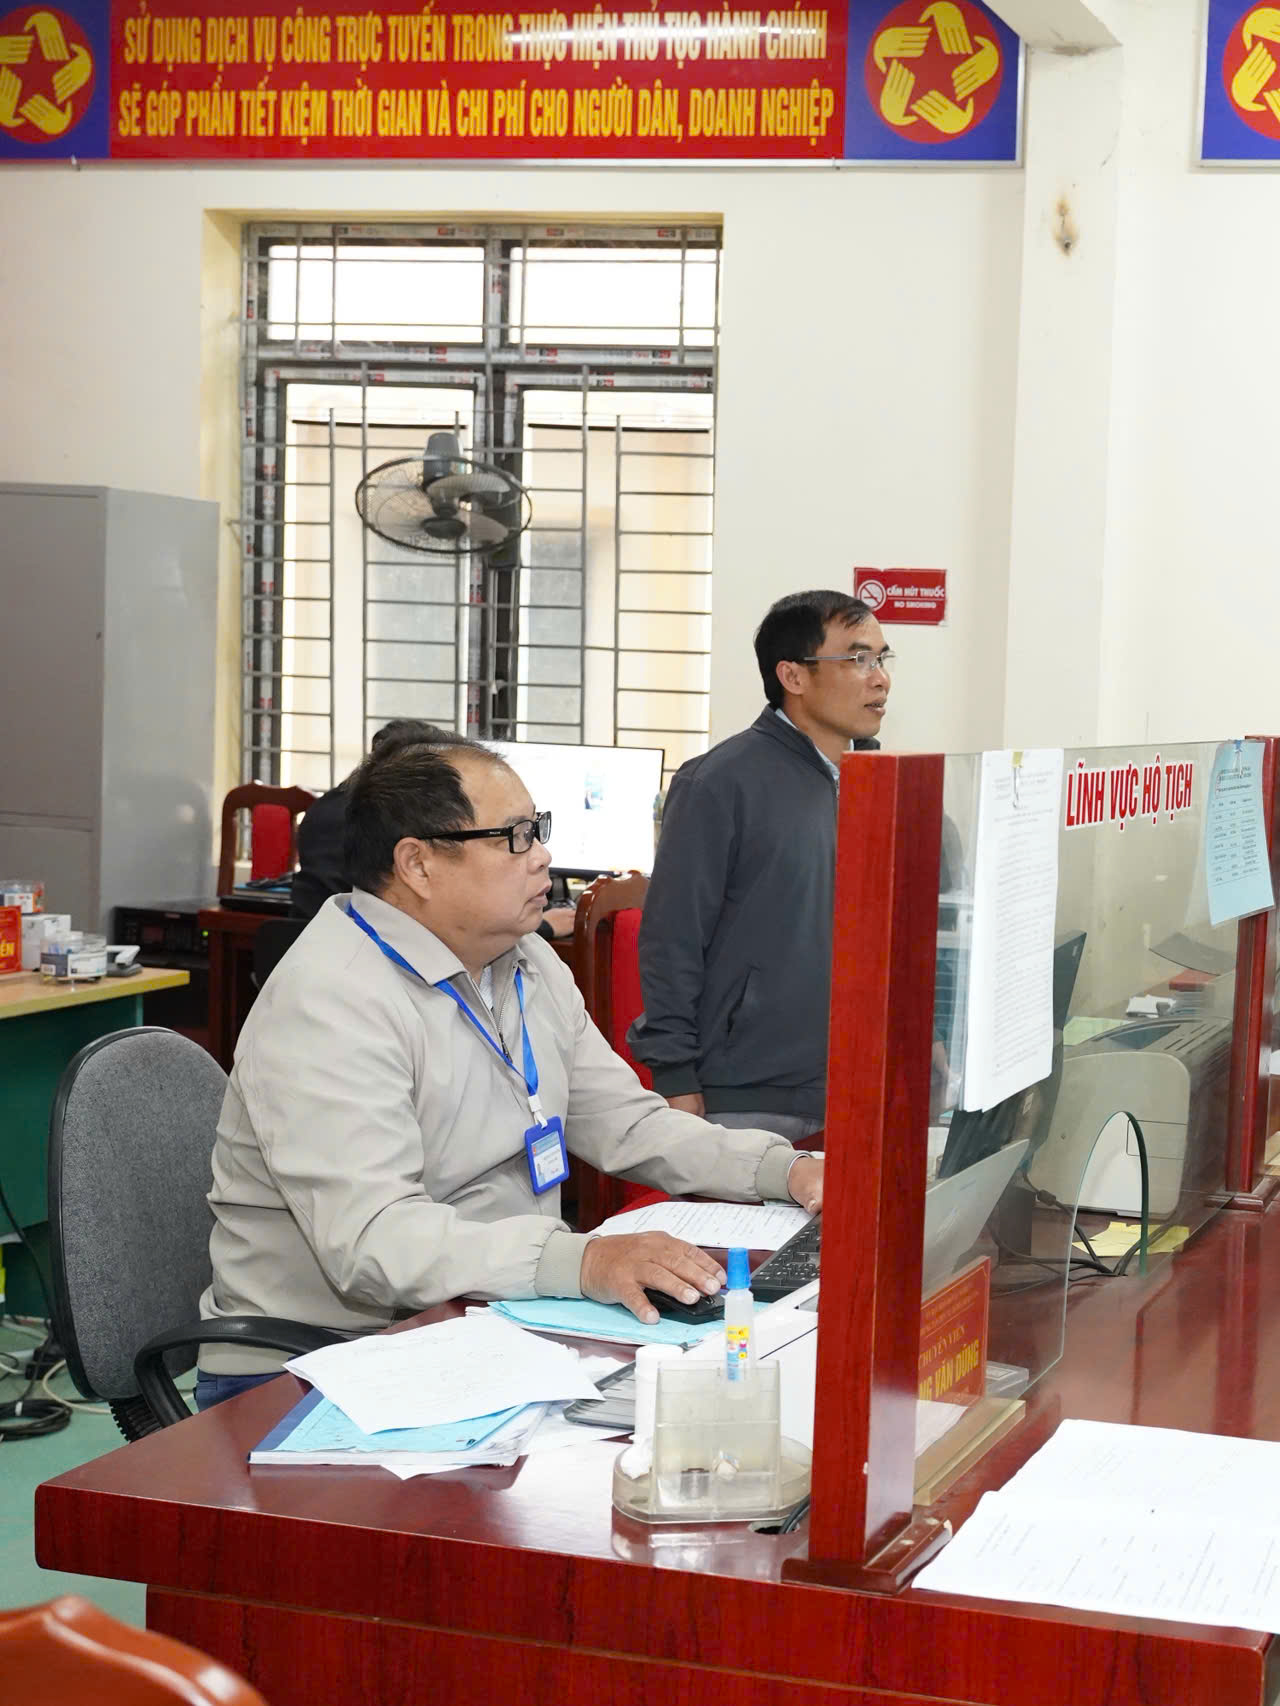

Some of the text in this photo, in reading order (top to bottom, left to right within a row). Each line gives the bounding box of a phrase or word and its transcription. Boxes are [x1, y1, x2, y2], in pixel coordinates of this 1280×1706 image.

[125, 1, 151, 63] SỬ
[153, 17, 201, 72] DỤNG
[206, 17, 249, 72] DỊCH
[253, 17, 277, 72] VỤ
[281, 7, 331, 63] CÔNG
[336, 10, 383, 72] TRỰC
[387, 1, 447, 62] TUYẾN
[452, 14, 514, 62] TRONG
[519, 8, 568, 71] THỰC
[572, 3, 618, 70] HIỆN
[664, 11, 702, 69] TỤC
[706, 1, 761, 60] HÀNH
[765, 1, 828, 60] CHÍNH
[118, 82, 142, 136] SẼ
[145, 80, 182, 136] GÓP
[240, 74, 277, 136] TIẾT
[281, 81, 328, 145] KIỆM
[332, 77, 373, 136] THỜI
[377, 89, 423, 136] GIAN
[427, 80, 451, 136] VÀ
[456, 89, 489, 136] CHI
[492, 79, 527, 136] PHÍ
[530, 88, 569, 136] CHO
[573, 75, 633, 136] NGƯỜI
[637, 79, 683, 143] DÂN,
[688, 88, 757, 136] DOANH
[761, 79, 834, 146] NGHIỆP
[1066, 755, 1193, 830] LĨNH VỰC HỘ TỊCH
